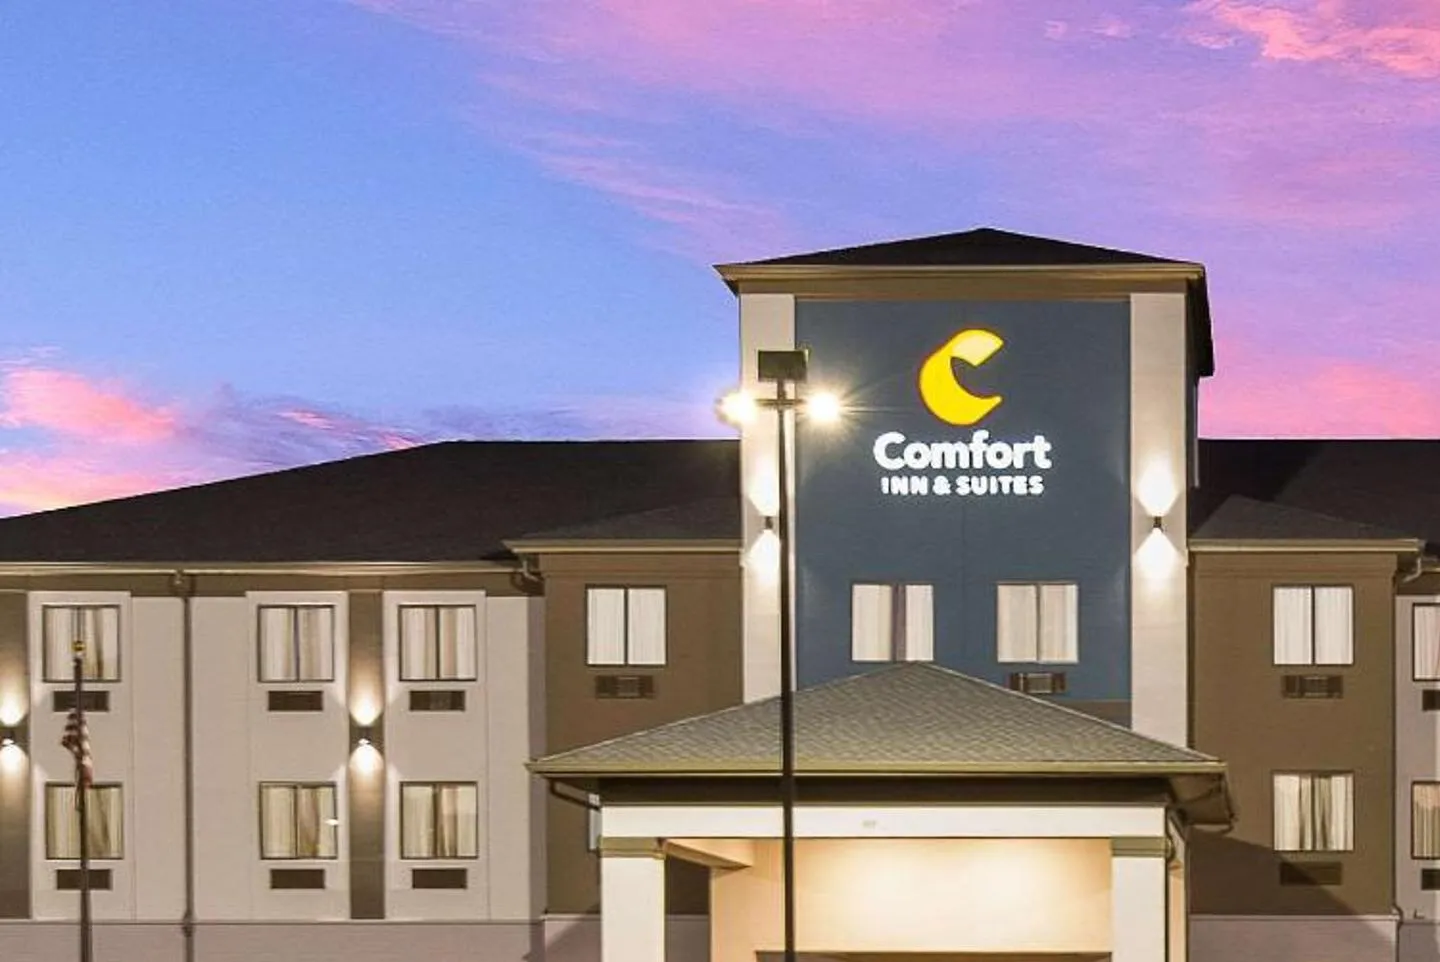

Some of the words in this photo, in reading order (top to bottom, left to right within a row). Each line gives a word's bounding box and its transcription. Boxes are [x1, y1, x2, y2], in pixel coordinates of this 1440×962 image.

[872, 429, 1053, 471] Comfort
[880, 475, 929, 496] INN
[932, 475, 952, 496] &
[955, 474, 1045, 496] SUITES
